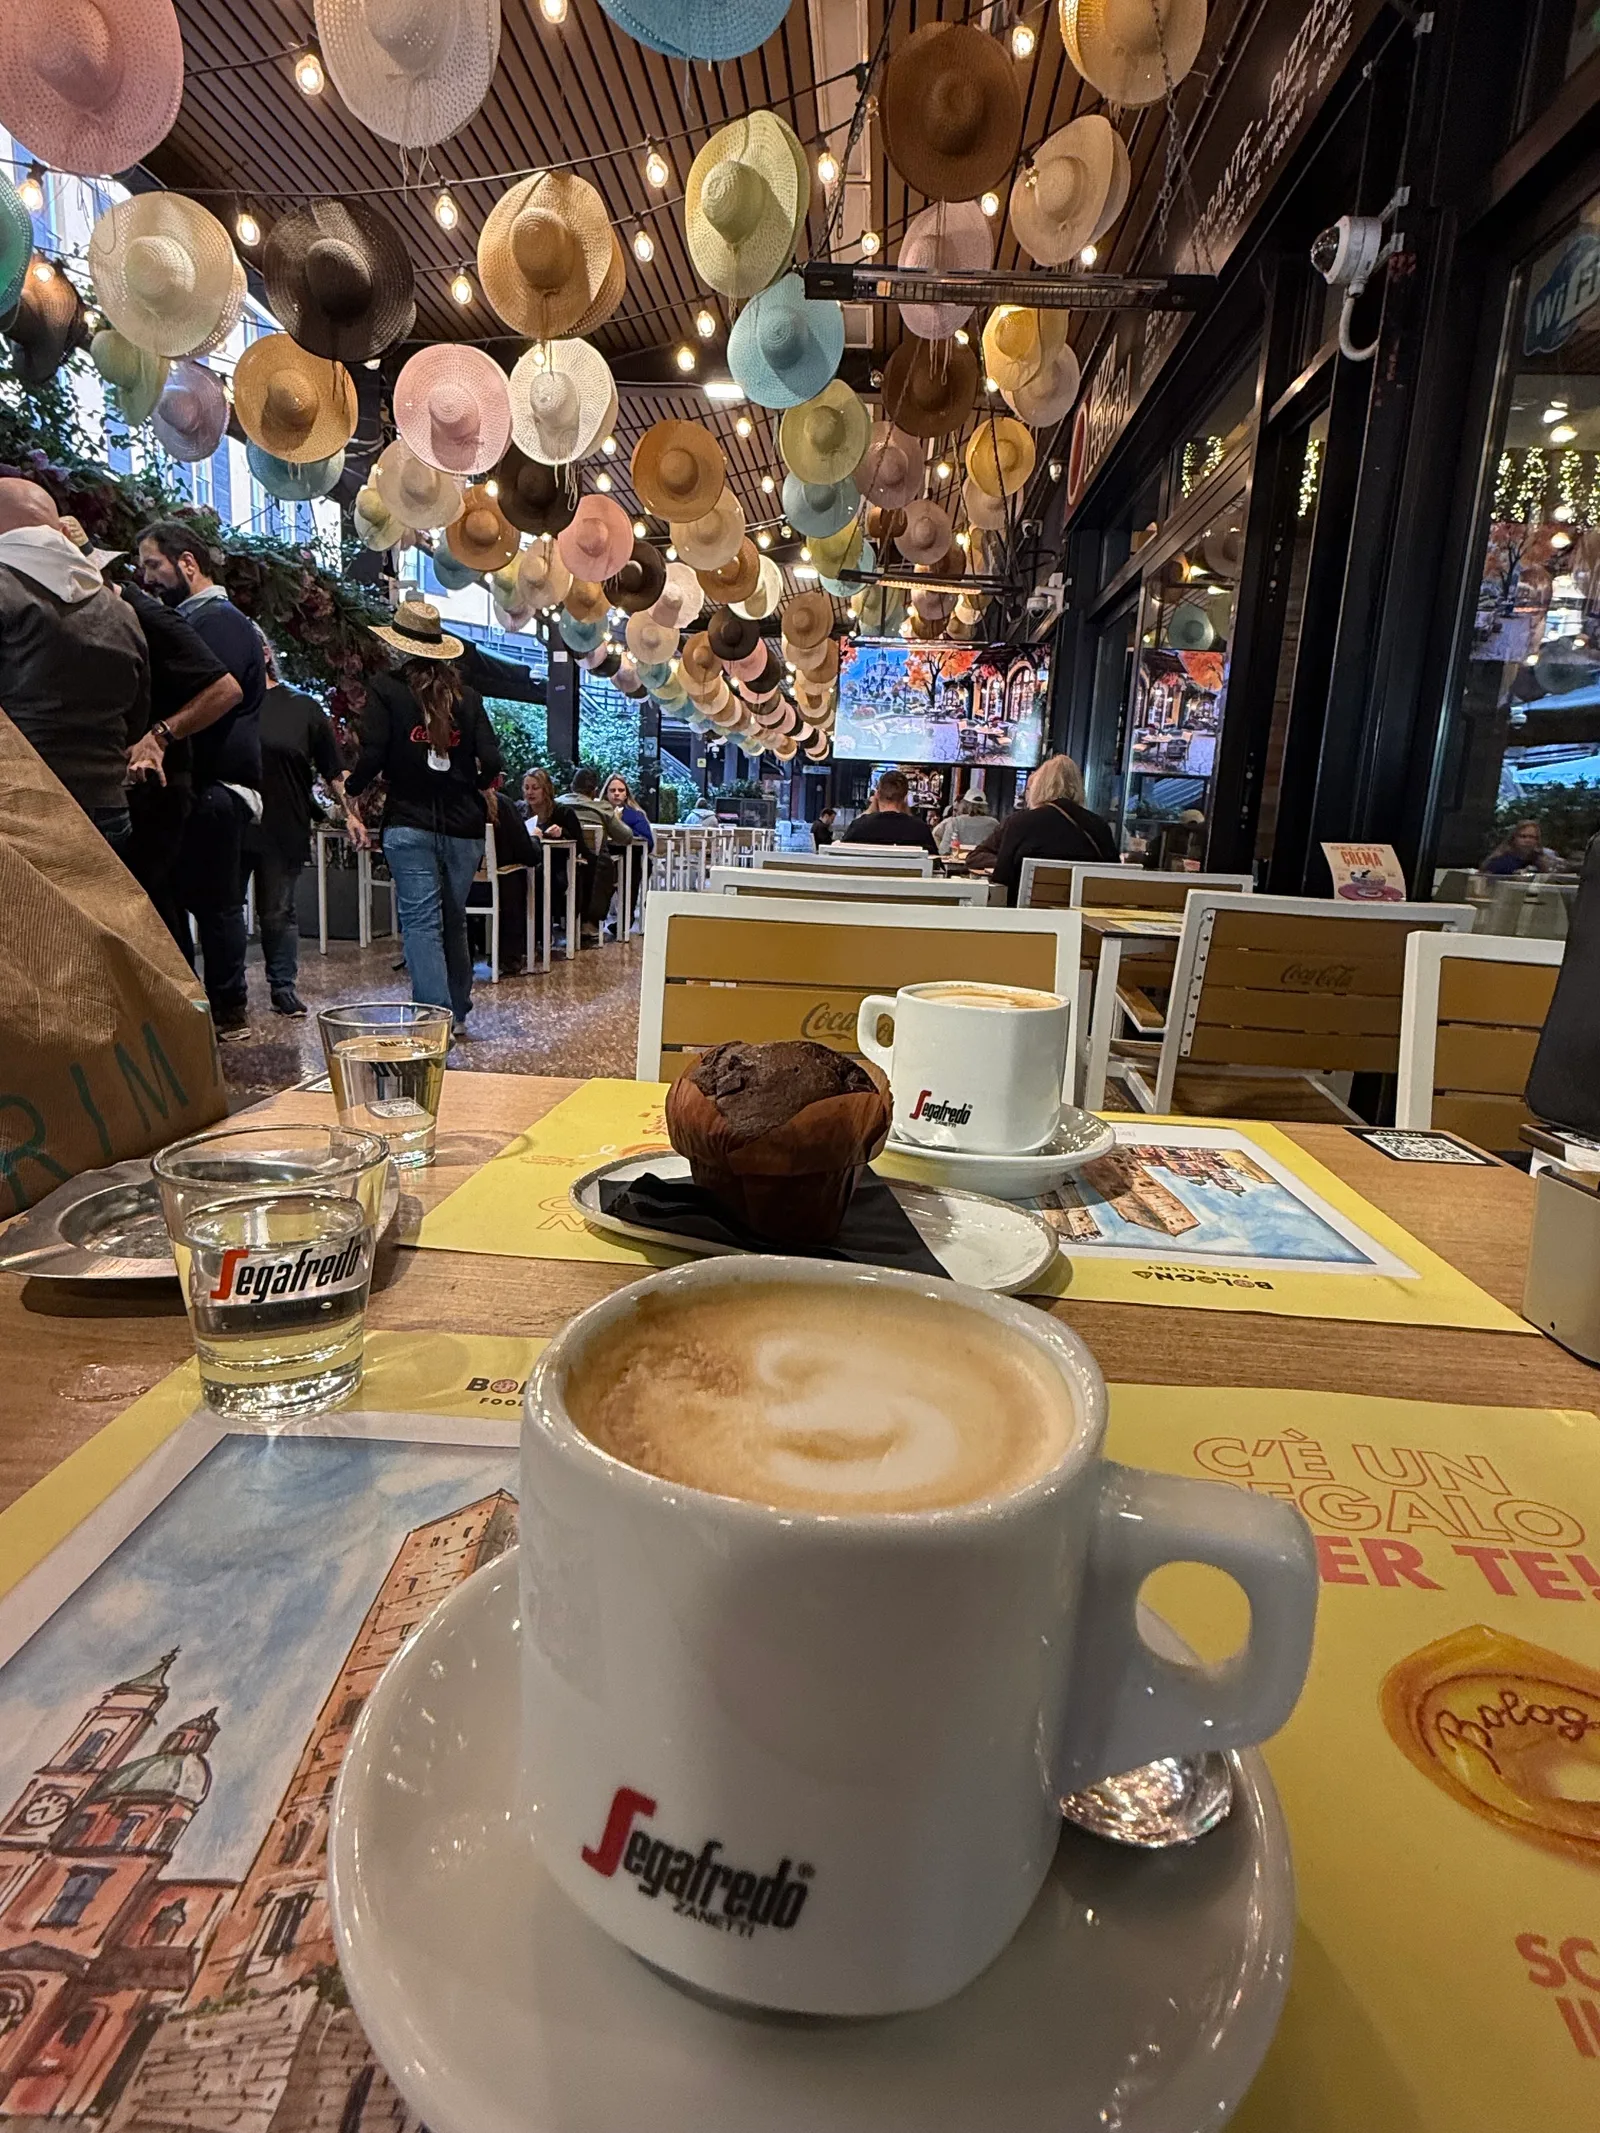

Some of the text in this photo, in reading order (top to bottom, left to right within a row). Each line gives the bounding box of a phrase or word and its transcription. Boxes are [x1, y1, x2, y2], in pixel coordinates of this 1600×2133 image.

[908, 1089, 973, 1125] Segafredo
[209, 1235, 362, 1304] Segafredo
[1351, 1443, 1513, 1497] UN
[1198, 1478, 1586, 1549] GALO
[1313, 1535, 1447, 1591] ER
[1436, 1689, 1600, 1768] Bolog
